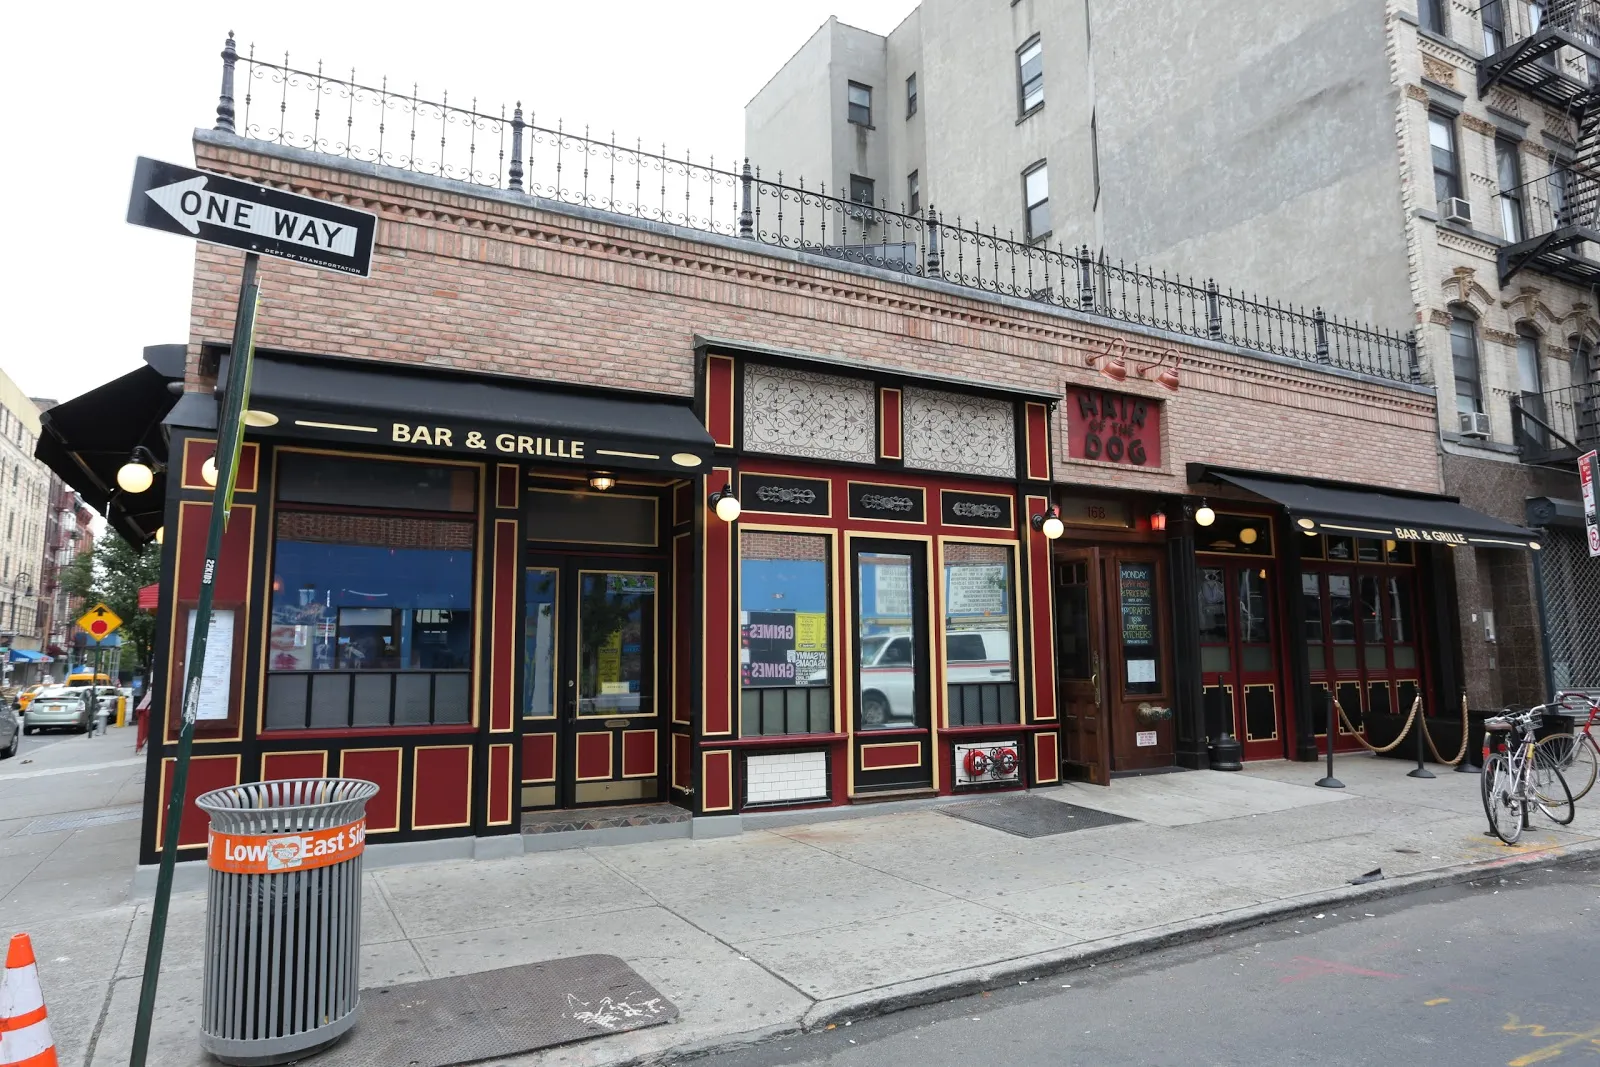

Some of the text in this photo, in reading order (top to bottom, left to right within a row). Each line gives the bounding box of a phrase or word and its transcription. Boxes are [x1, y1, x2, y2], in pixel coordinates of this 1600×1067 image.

[180, 190, 343, 249] ONE WAY
[264, 248, 284, 256] DEPT
[299, 255, 361, 274] TRANSPORTATION
[1078, 390, 1148, 430] HAIR
[1089, 418, 1135, 438] OF THE
[391, 423, 585, 460] BAR & GRILLE
[1085, 432, 1147, 465] DOG
[1088, 506, 1106, 519] 168
[1395, 527, 1468, 544] BAR & GRILLE
[202, 559, 215, 584] 22KIDS
[1121, 570, 1147, 579] MONDAY
[225, 838, 269, 861] Low
[303, 830, 345, 858] East
